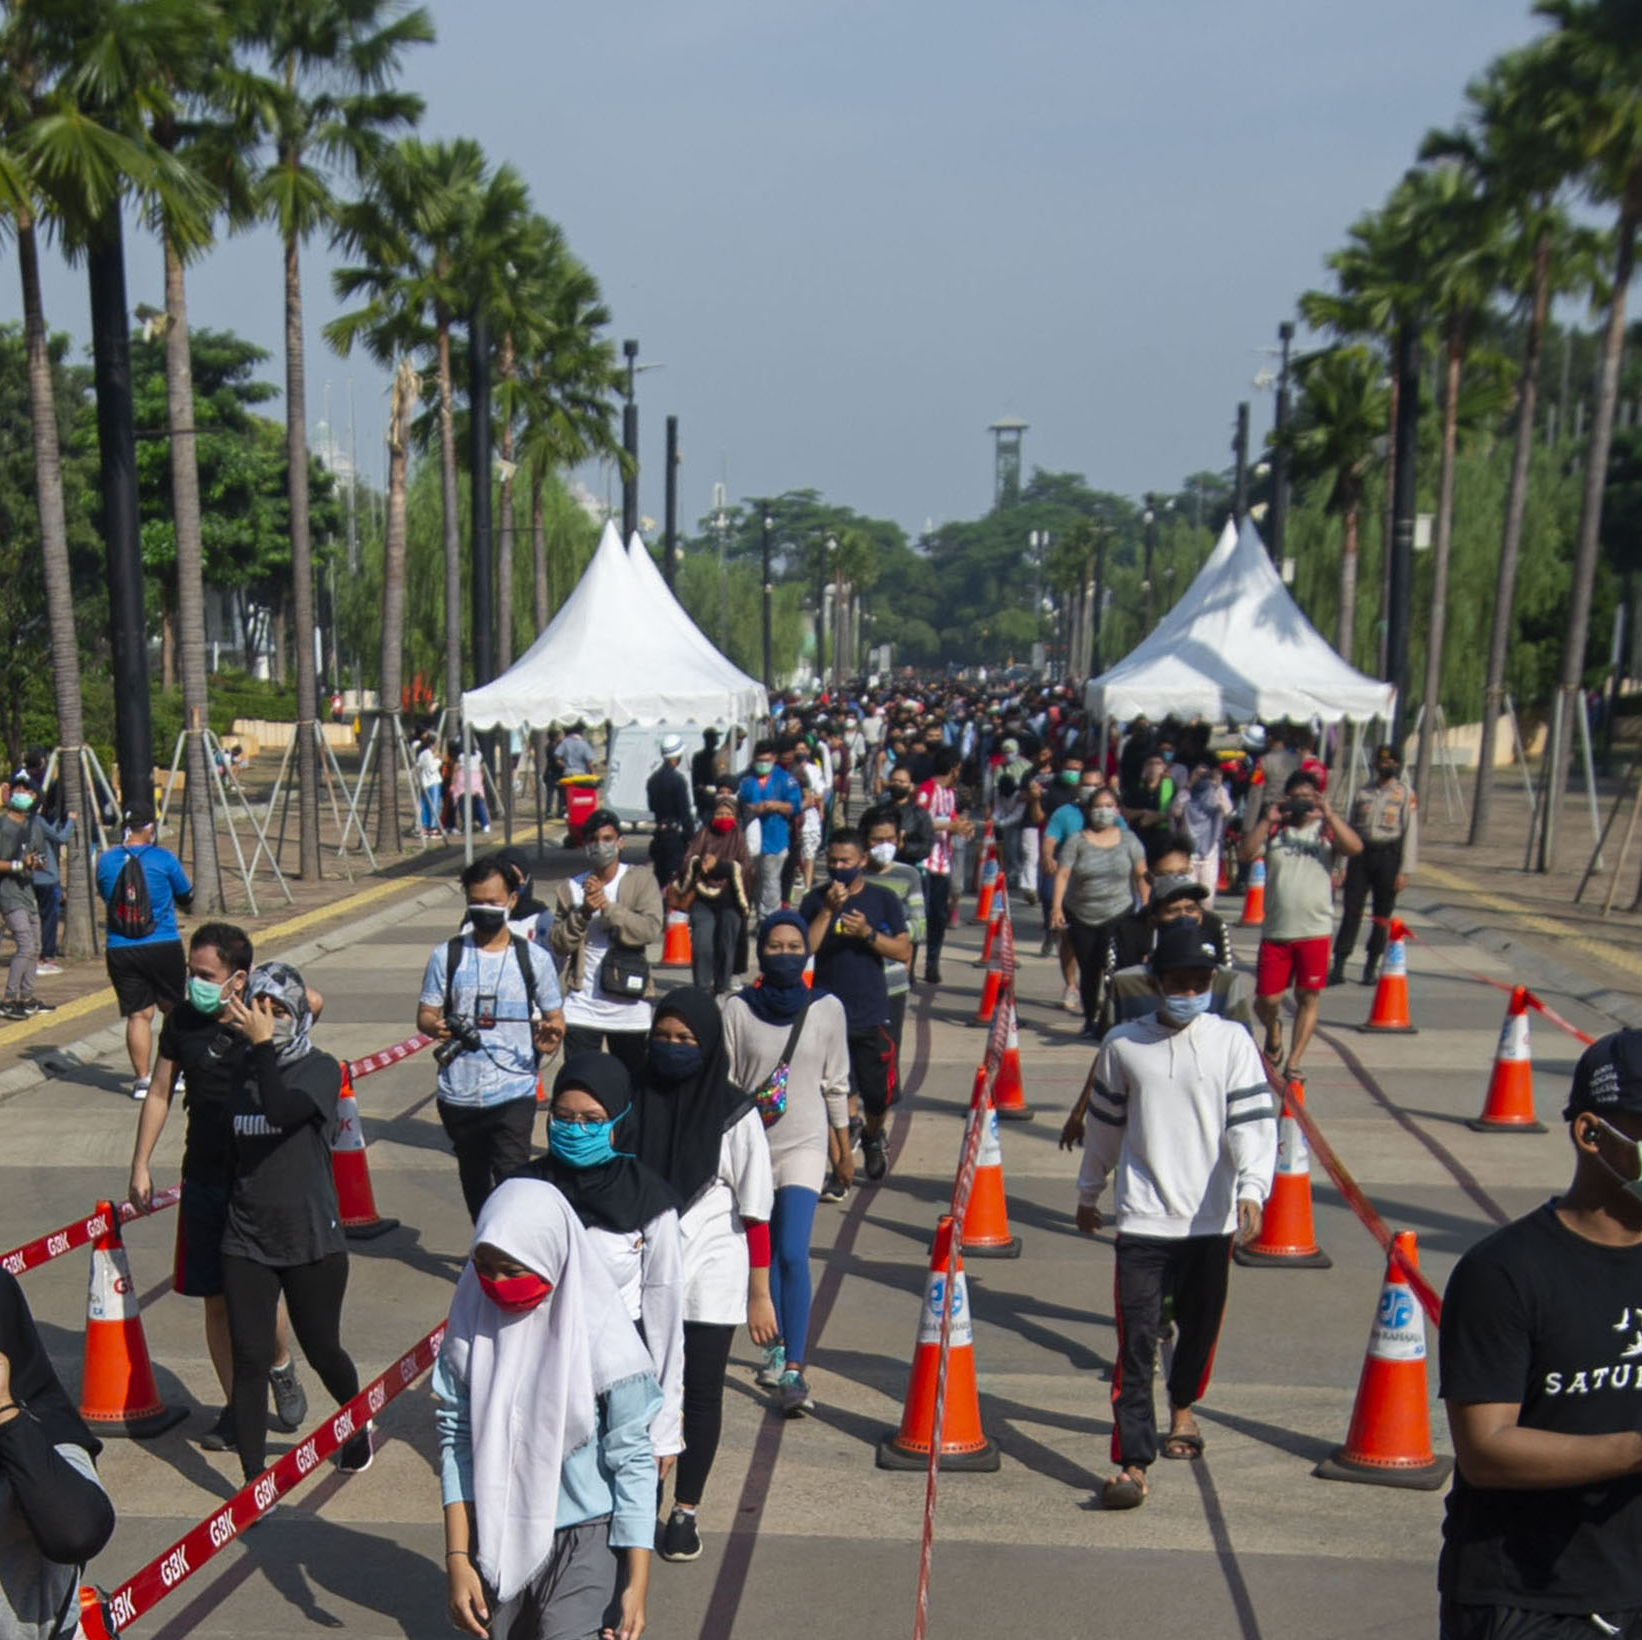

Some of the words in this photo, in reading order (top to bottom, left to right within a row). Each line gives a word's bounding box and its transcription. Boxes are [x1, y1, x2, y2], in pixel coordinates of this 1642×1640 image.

[47, 1231, 70, 1256] GBK
[86, 1214, 108, 1238] GBK
[160, 1545, 190, 1587] GBK
[210, 1507, 237, 1547] GBK
[254, 1471, 279, 1511] GBK
[296, 1438, 319, 1475] GBK
[334, 1408, 356, 1442] GBK
